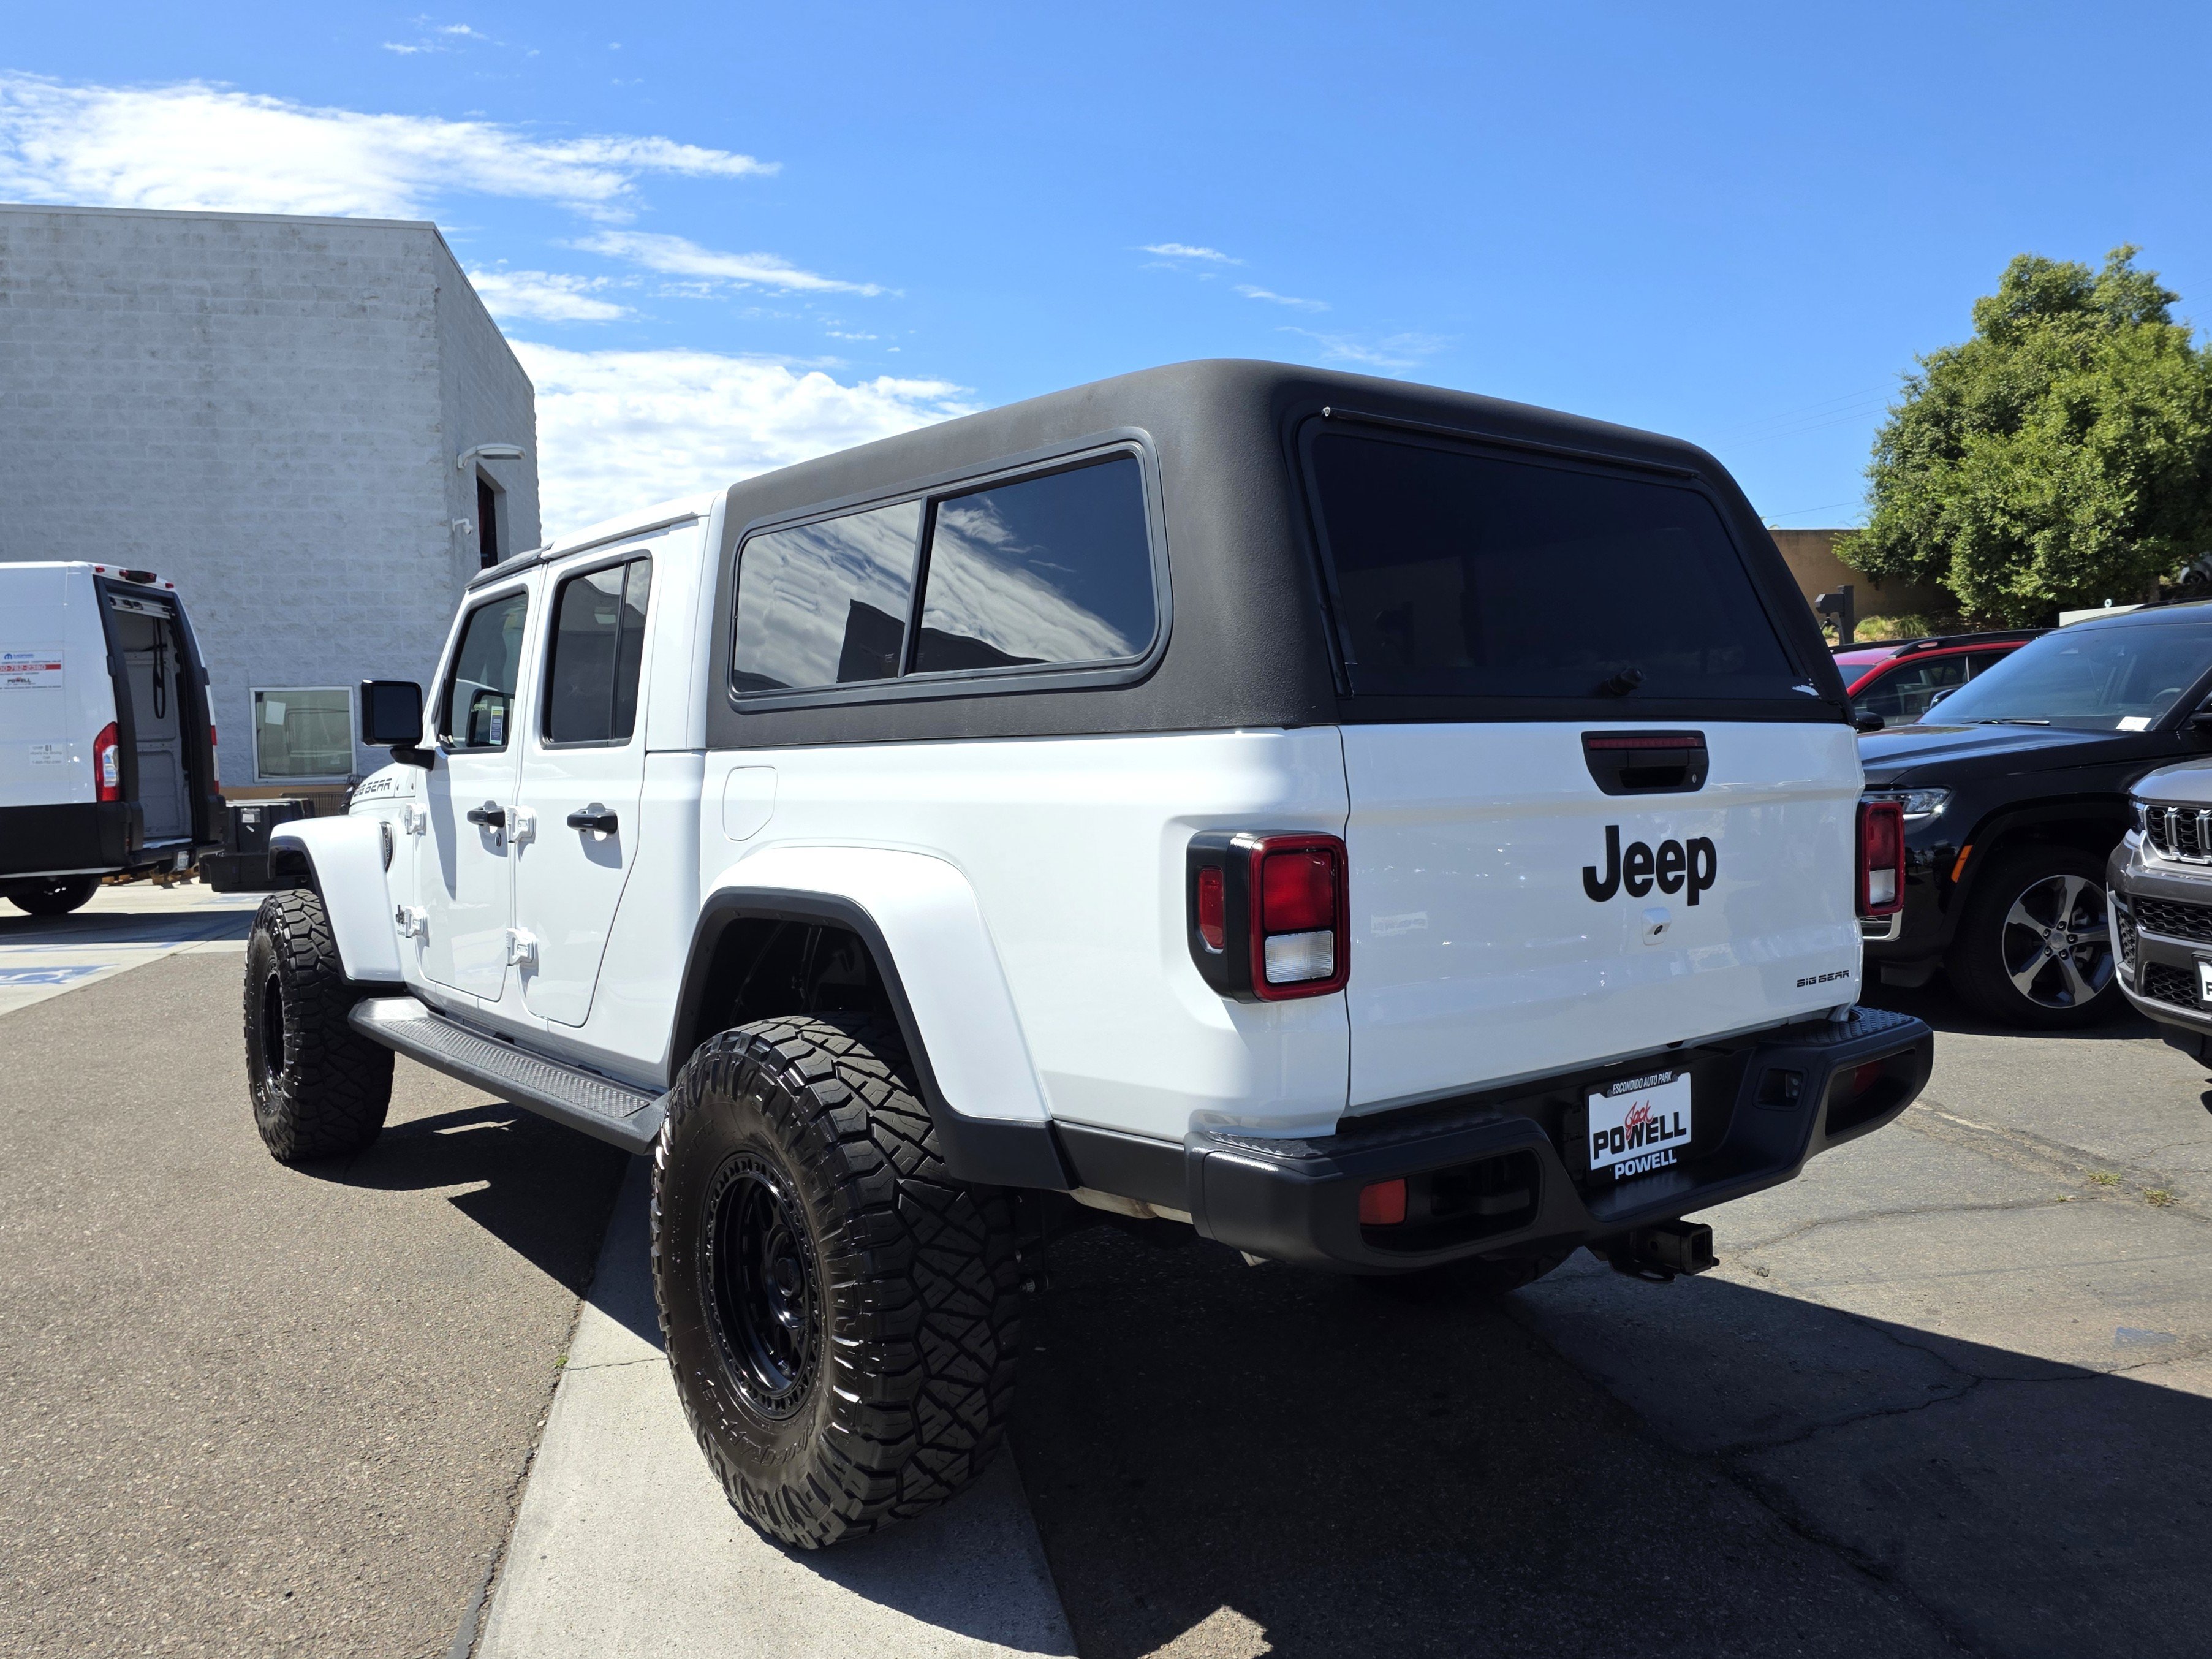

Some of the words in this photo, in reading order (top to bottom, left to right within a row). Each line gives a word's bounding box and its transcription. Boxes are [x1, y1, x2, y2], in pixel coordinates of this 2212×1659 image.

[365, 778, 392, 794] BEAR
[1583, 825, 1717, 906] Jeep
[1797, 976, 1817, 988] BIG
[1818, 970, 1849, 983] BEAR
[1612, 1077, 1643, 1095] ESCONDIDO
[1643, 1074, 1657, 1088] AUTO
[1658, 1071, 1672, 1084] PARK
[1593, 1111, 1687, 1160] POWELL
[1625, 1099, 1654, 1141] Jack
[1615, 1149, 1677, 1180] POWELL
